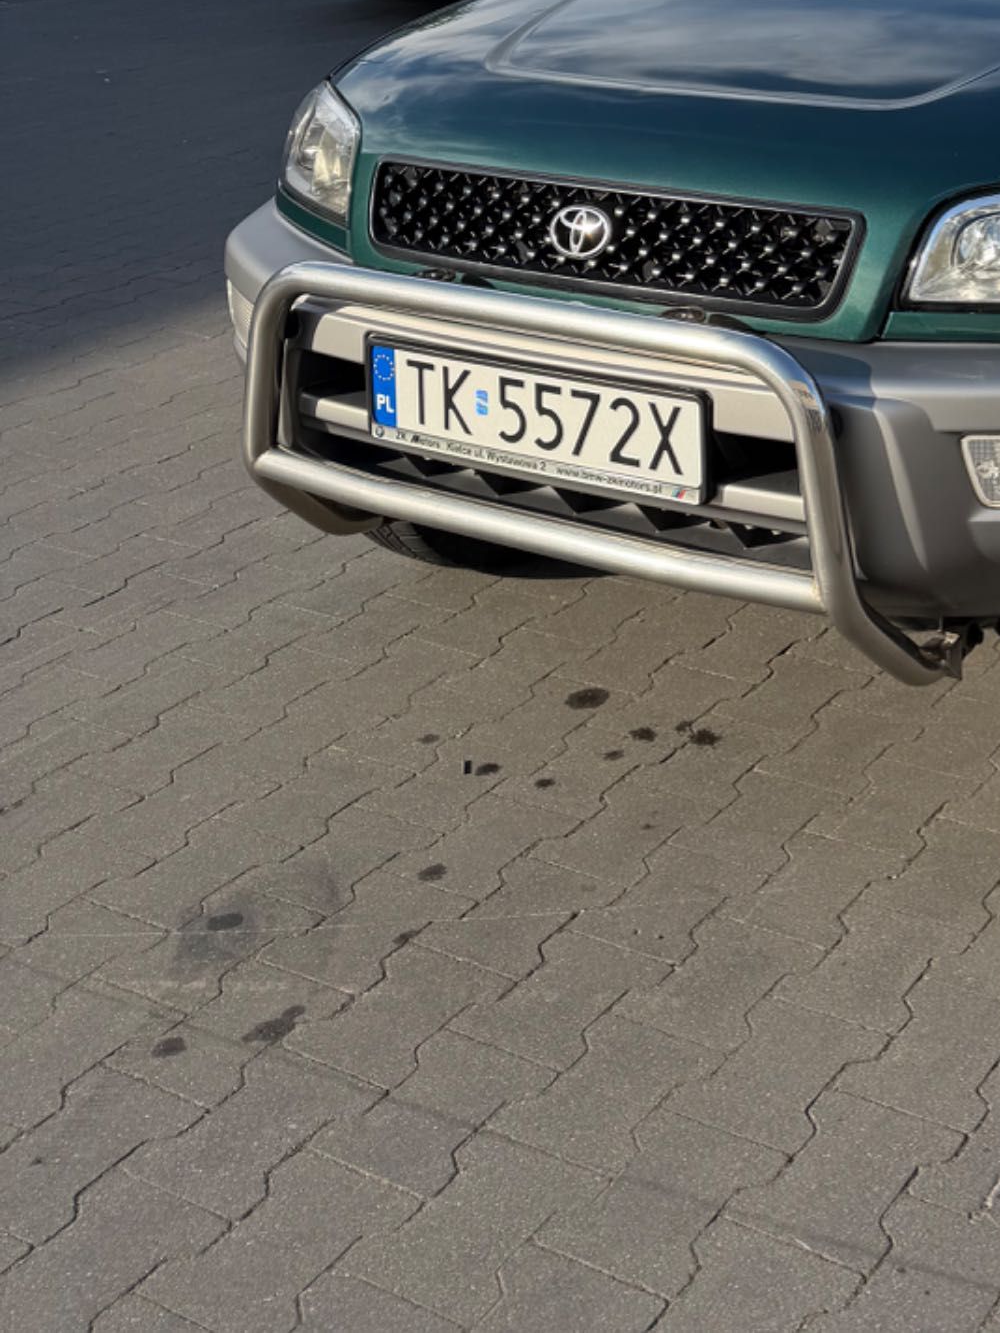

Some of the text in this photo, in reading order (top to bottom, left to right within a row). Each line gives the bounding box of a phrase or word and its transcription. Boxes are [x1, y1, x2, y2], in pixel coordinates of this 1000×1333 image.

[376, 393, 394, 413] PL
[406, 359, 685, 476] TK 5572X
